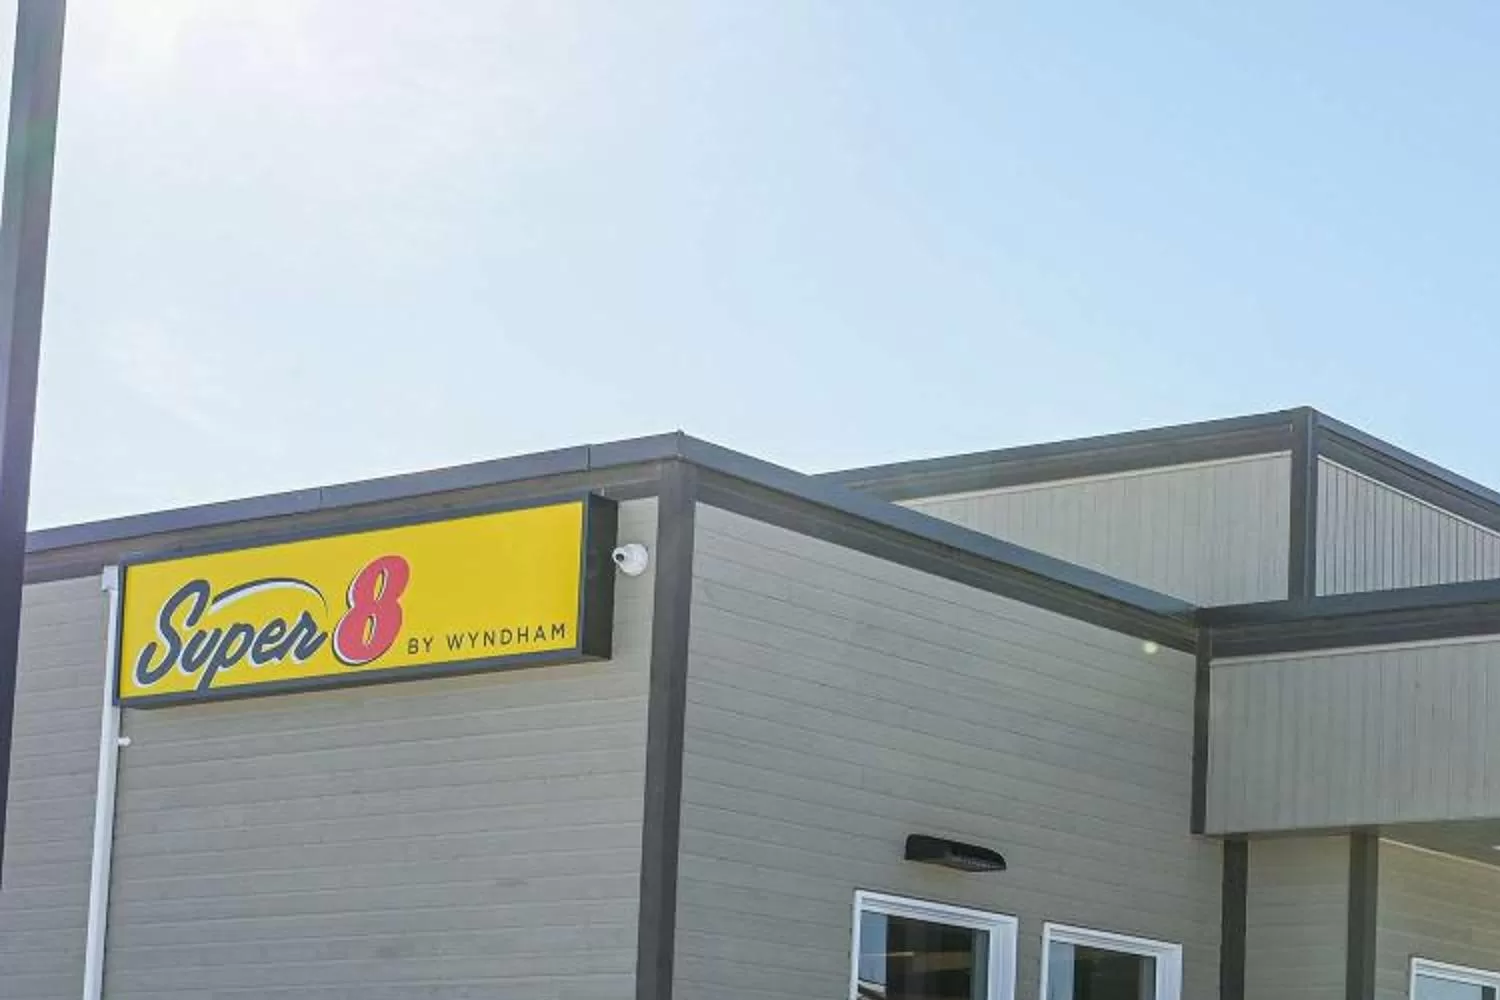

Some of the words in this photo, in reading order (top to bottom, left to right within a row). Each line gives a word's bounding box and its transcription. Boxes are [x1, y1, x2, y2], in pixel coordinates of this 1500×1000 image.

[133, 578, 328, 691] Super
[332, 554, 410, 666] 8
[407, 636, 434, 655] BY
[446, 623, 566, 651] WYNDHAM
